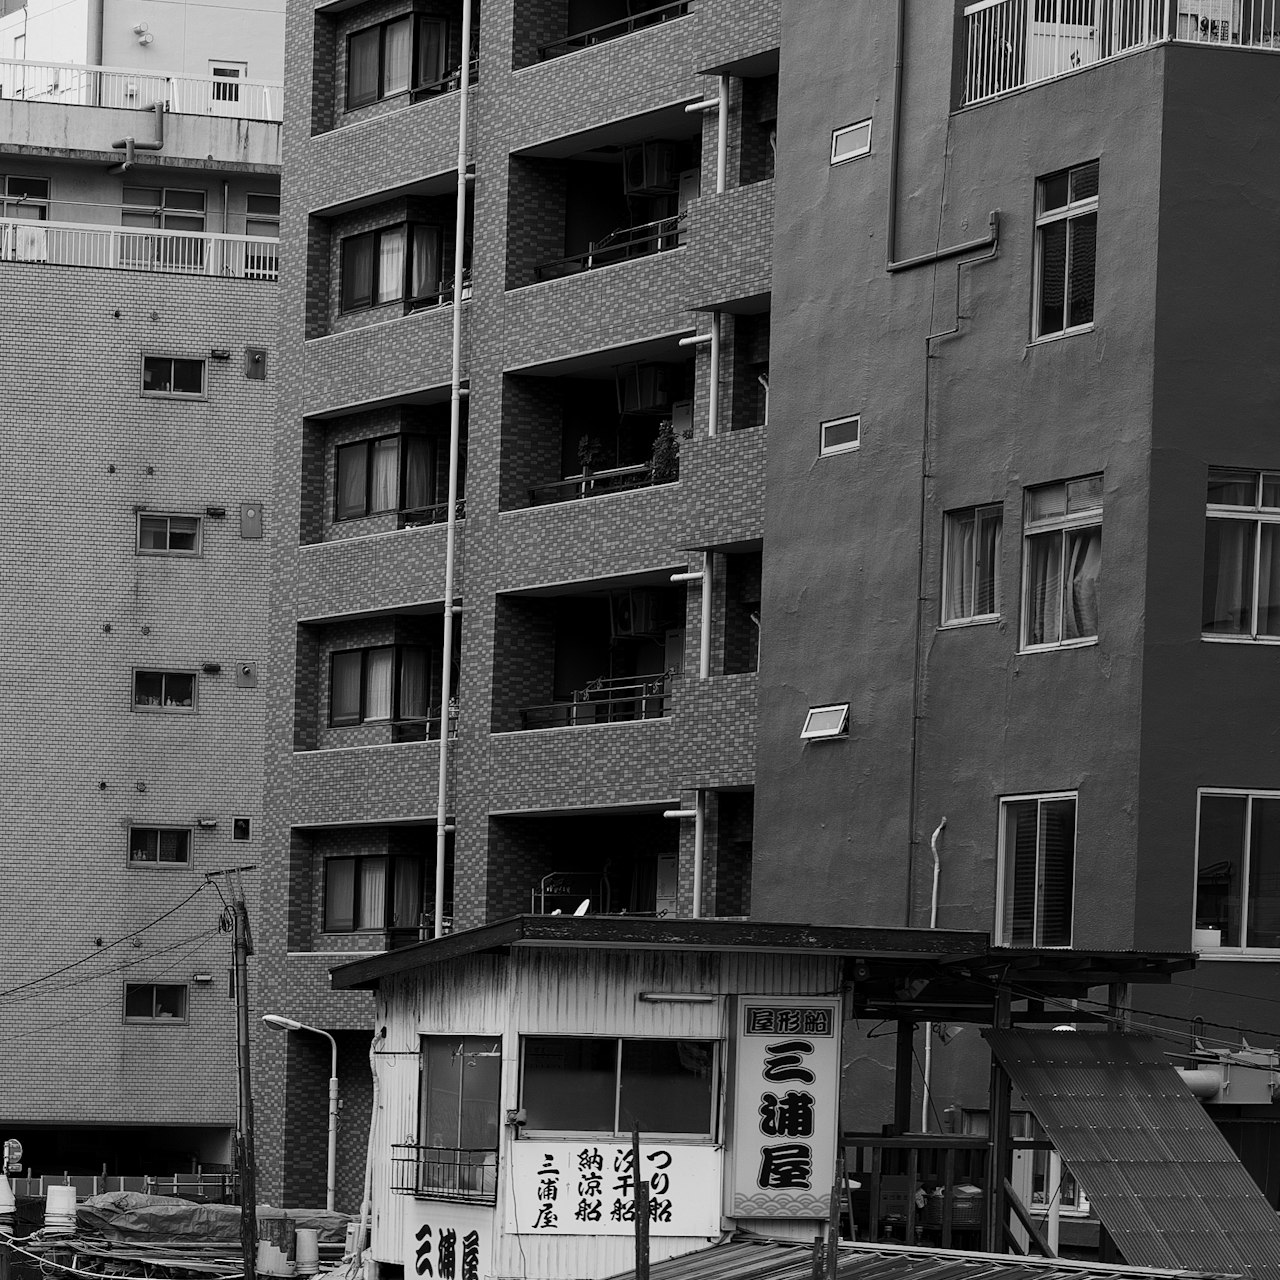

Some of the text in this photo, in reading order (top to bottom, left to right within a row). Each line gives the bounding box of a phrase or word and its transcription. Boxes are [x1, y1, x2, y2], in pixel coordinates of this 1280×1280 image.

[751, 1009, 829, 1034] 屋形船
[757, 1039, 816, 1191] 三浦屋
[531, 1153, 560, 1229] 三浦屋
[574, 1147, 604, 1222] 納涼船
[646, 1150, 673, 1223] つり船
